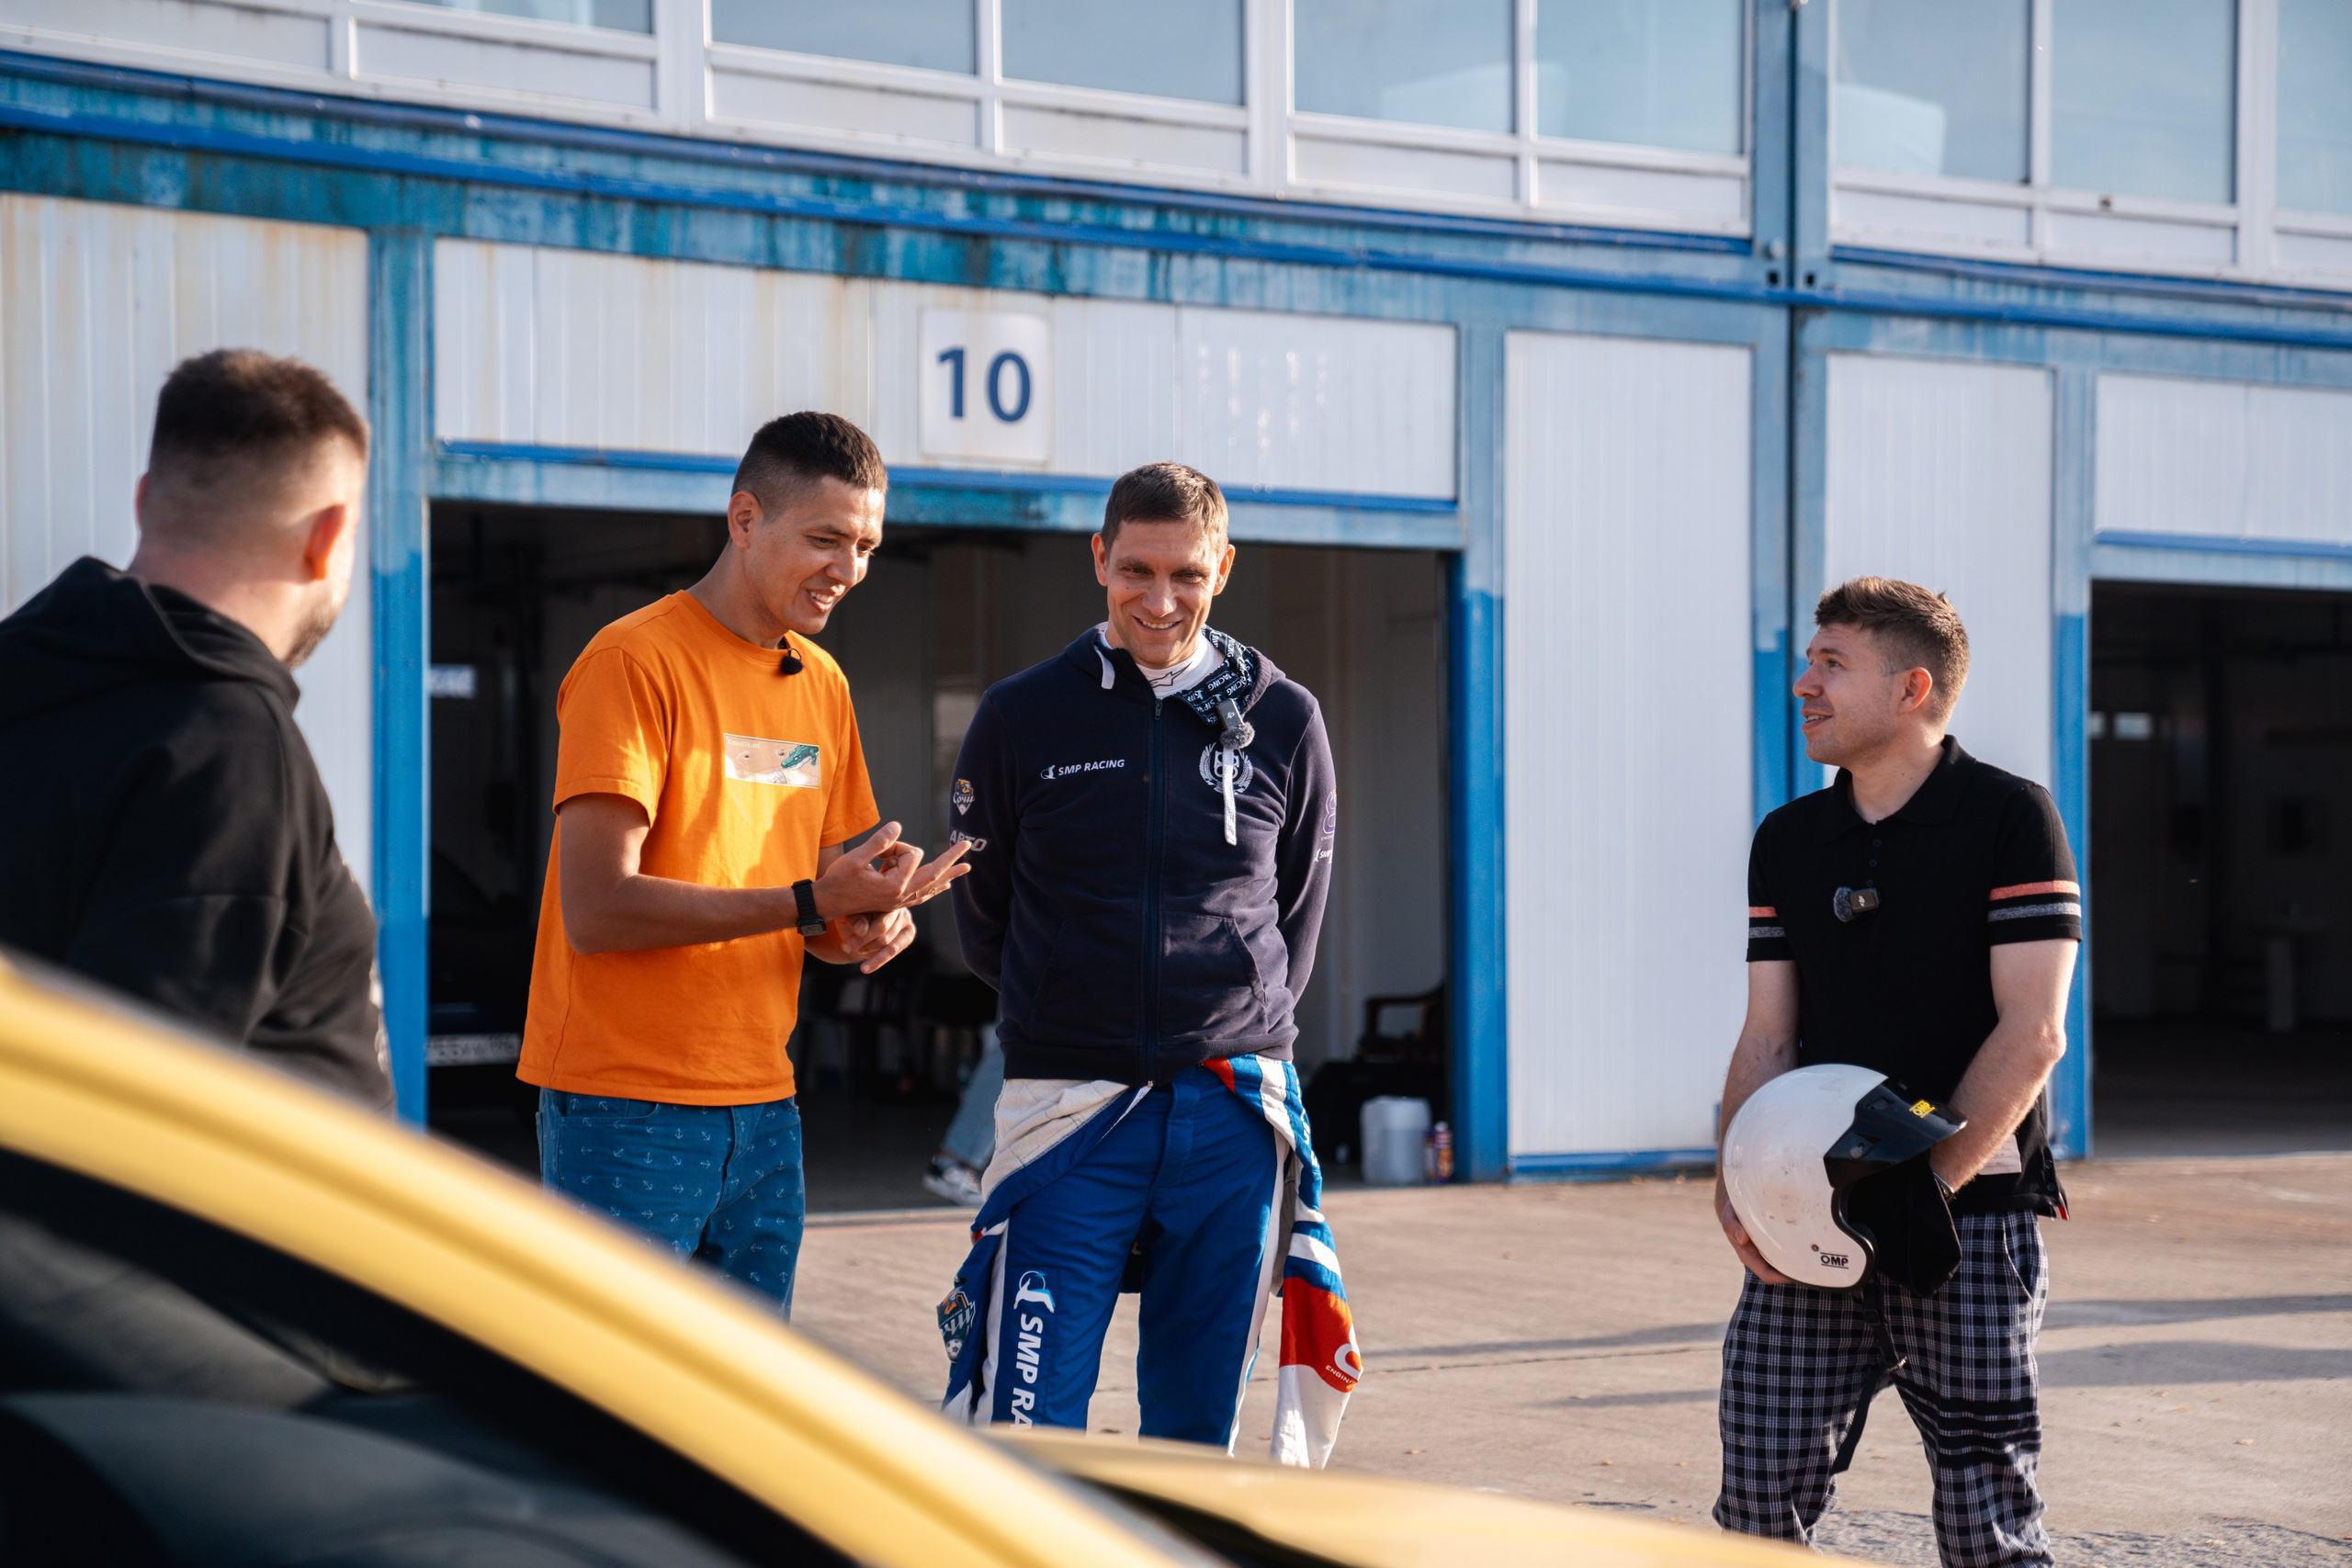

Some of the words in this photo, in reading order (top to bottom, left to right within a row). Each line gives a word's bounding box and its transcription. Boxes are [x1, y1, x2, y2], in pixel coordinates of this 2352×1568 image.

[937, 346, 1032, 423] 10
[1057, 763, 1082, 776] SMP
[1083, 759, 1125, 772] RACING
[953, 791, 975, 804] Сочи
[1911, 1100, 1932, 1117] OMP
[1820, 1255, 1849, 1267] OMP
[1015, 1313, 1044, 1384] SMP
